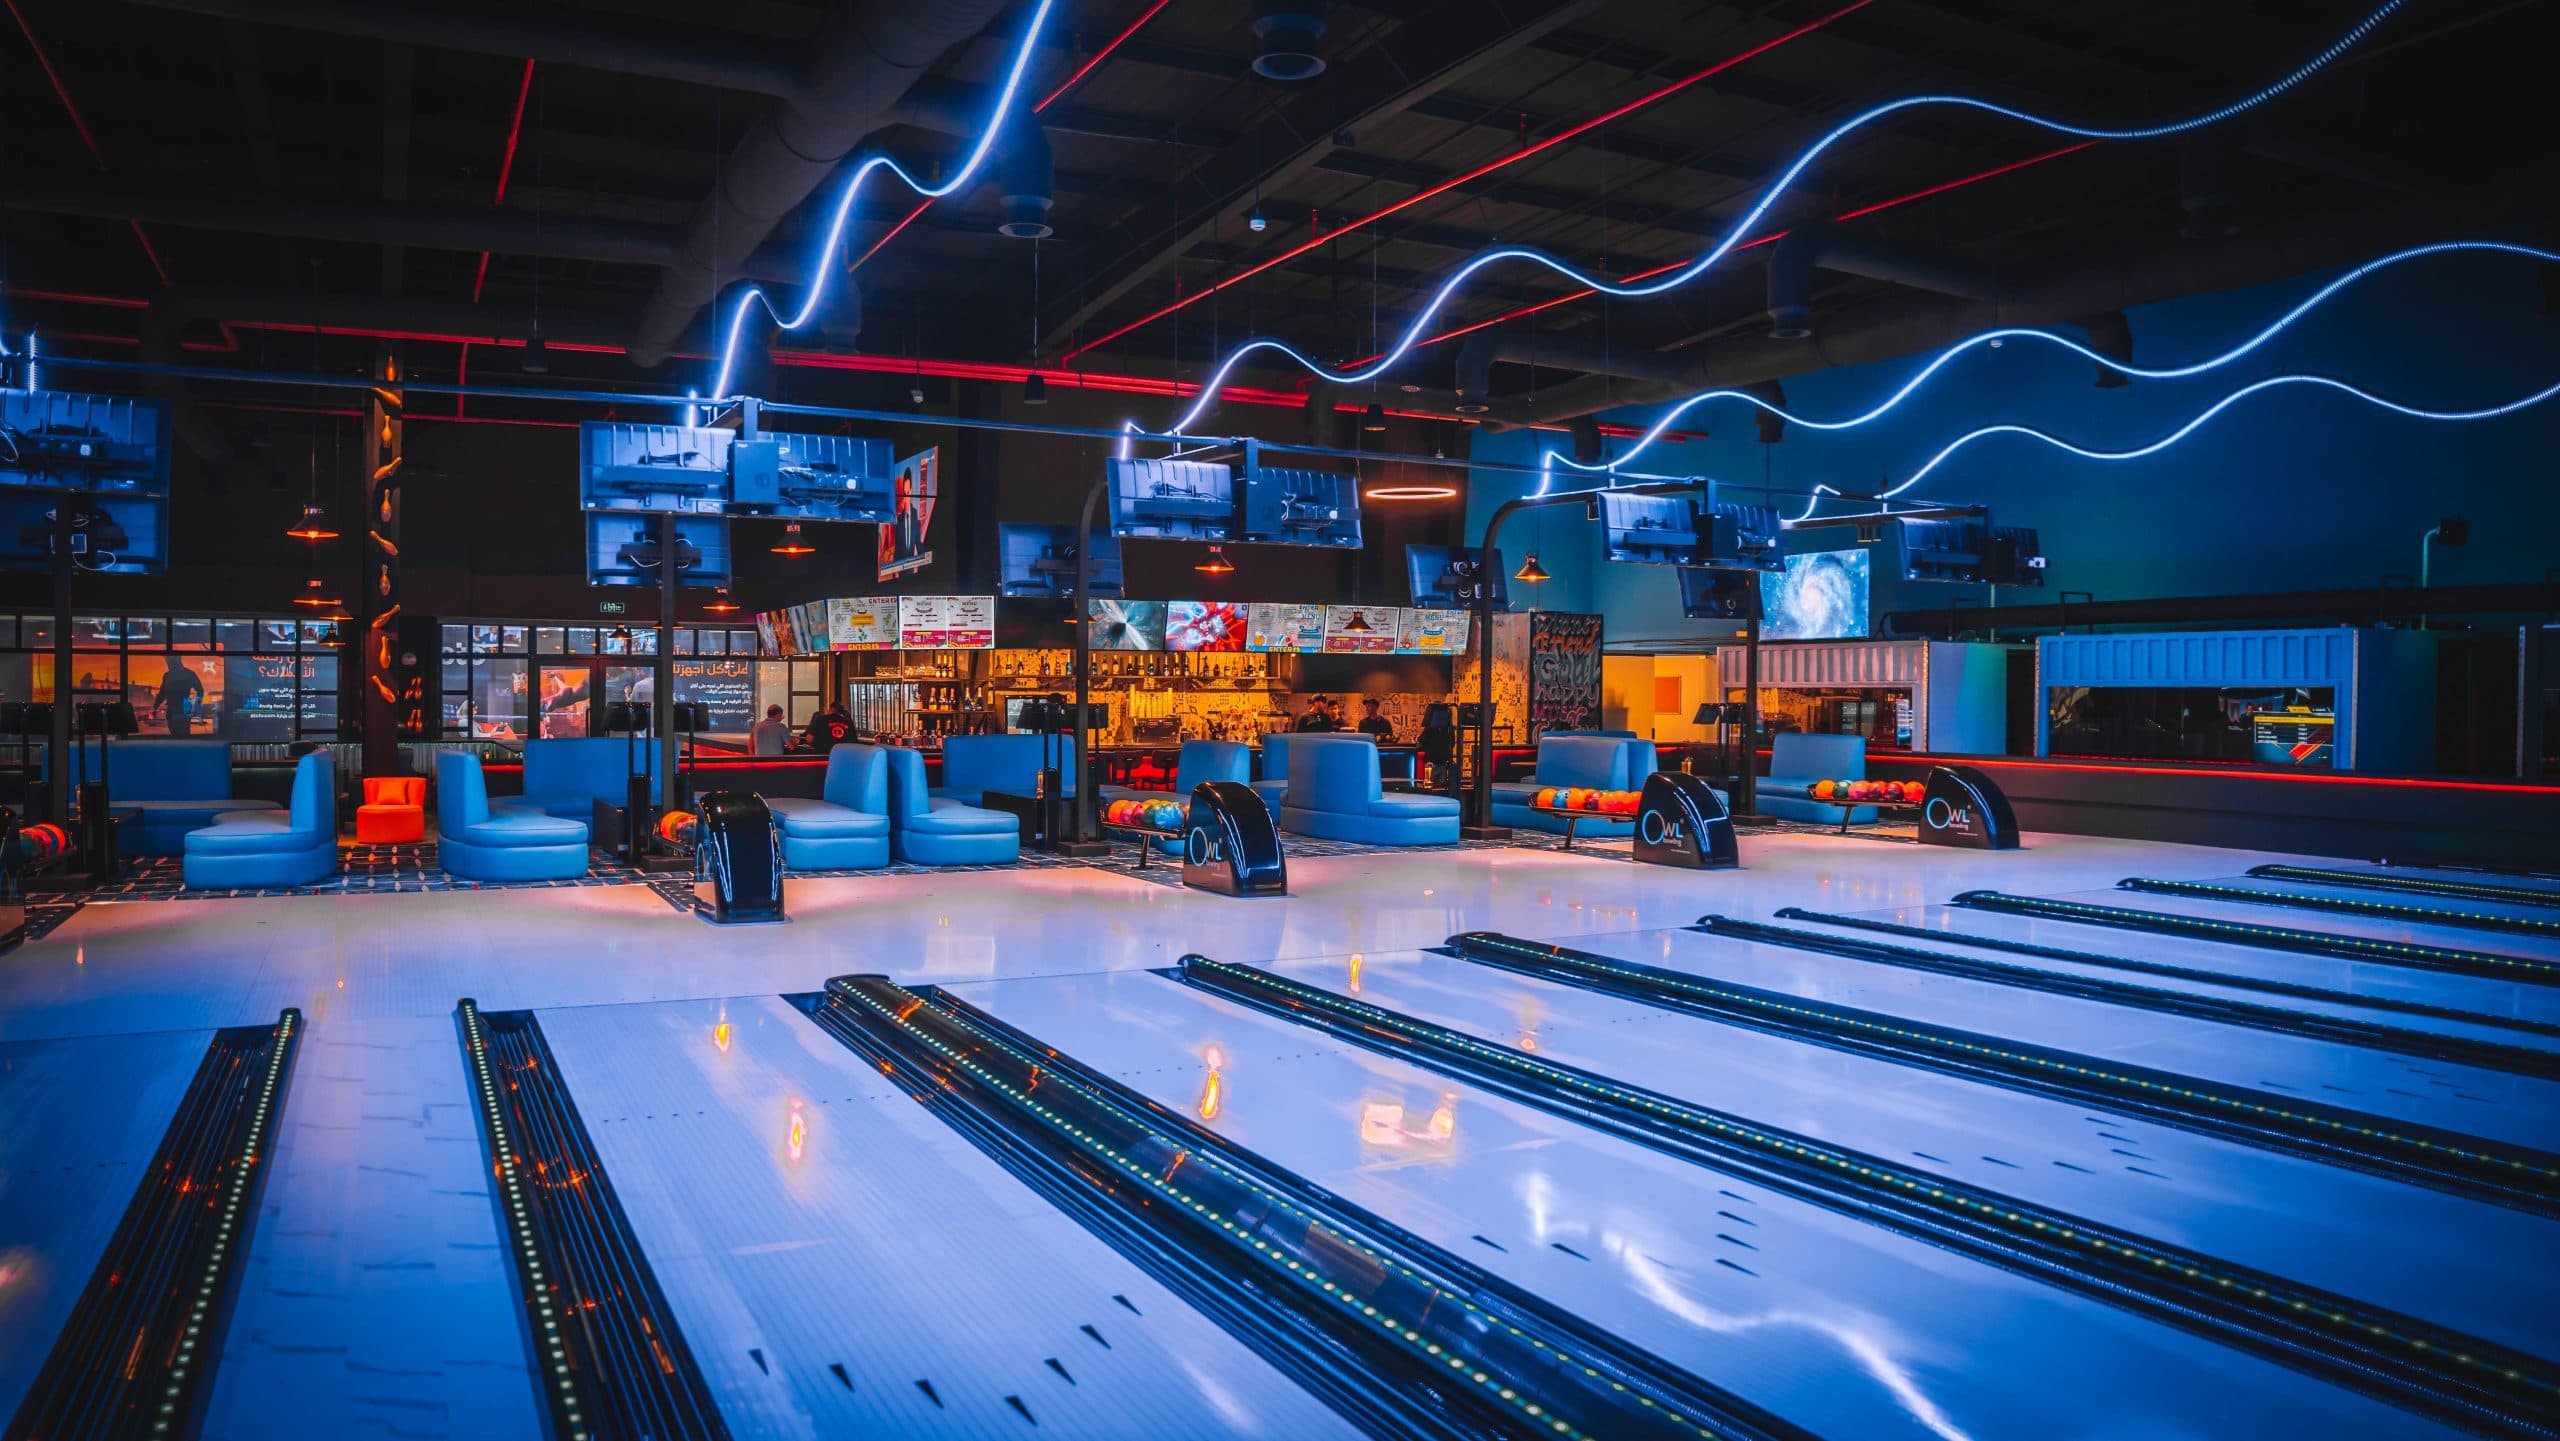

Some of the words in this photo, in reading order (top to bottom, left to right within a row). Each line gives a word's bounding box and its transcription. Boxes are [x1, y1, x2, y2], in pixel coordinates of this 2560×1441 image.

[1642, 809, 1684, 845] OWL
[1926, 797, 1971, 829] OWL
[1189, 826, 1222, 867] OWL
